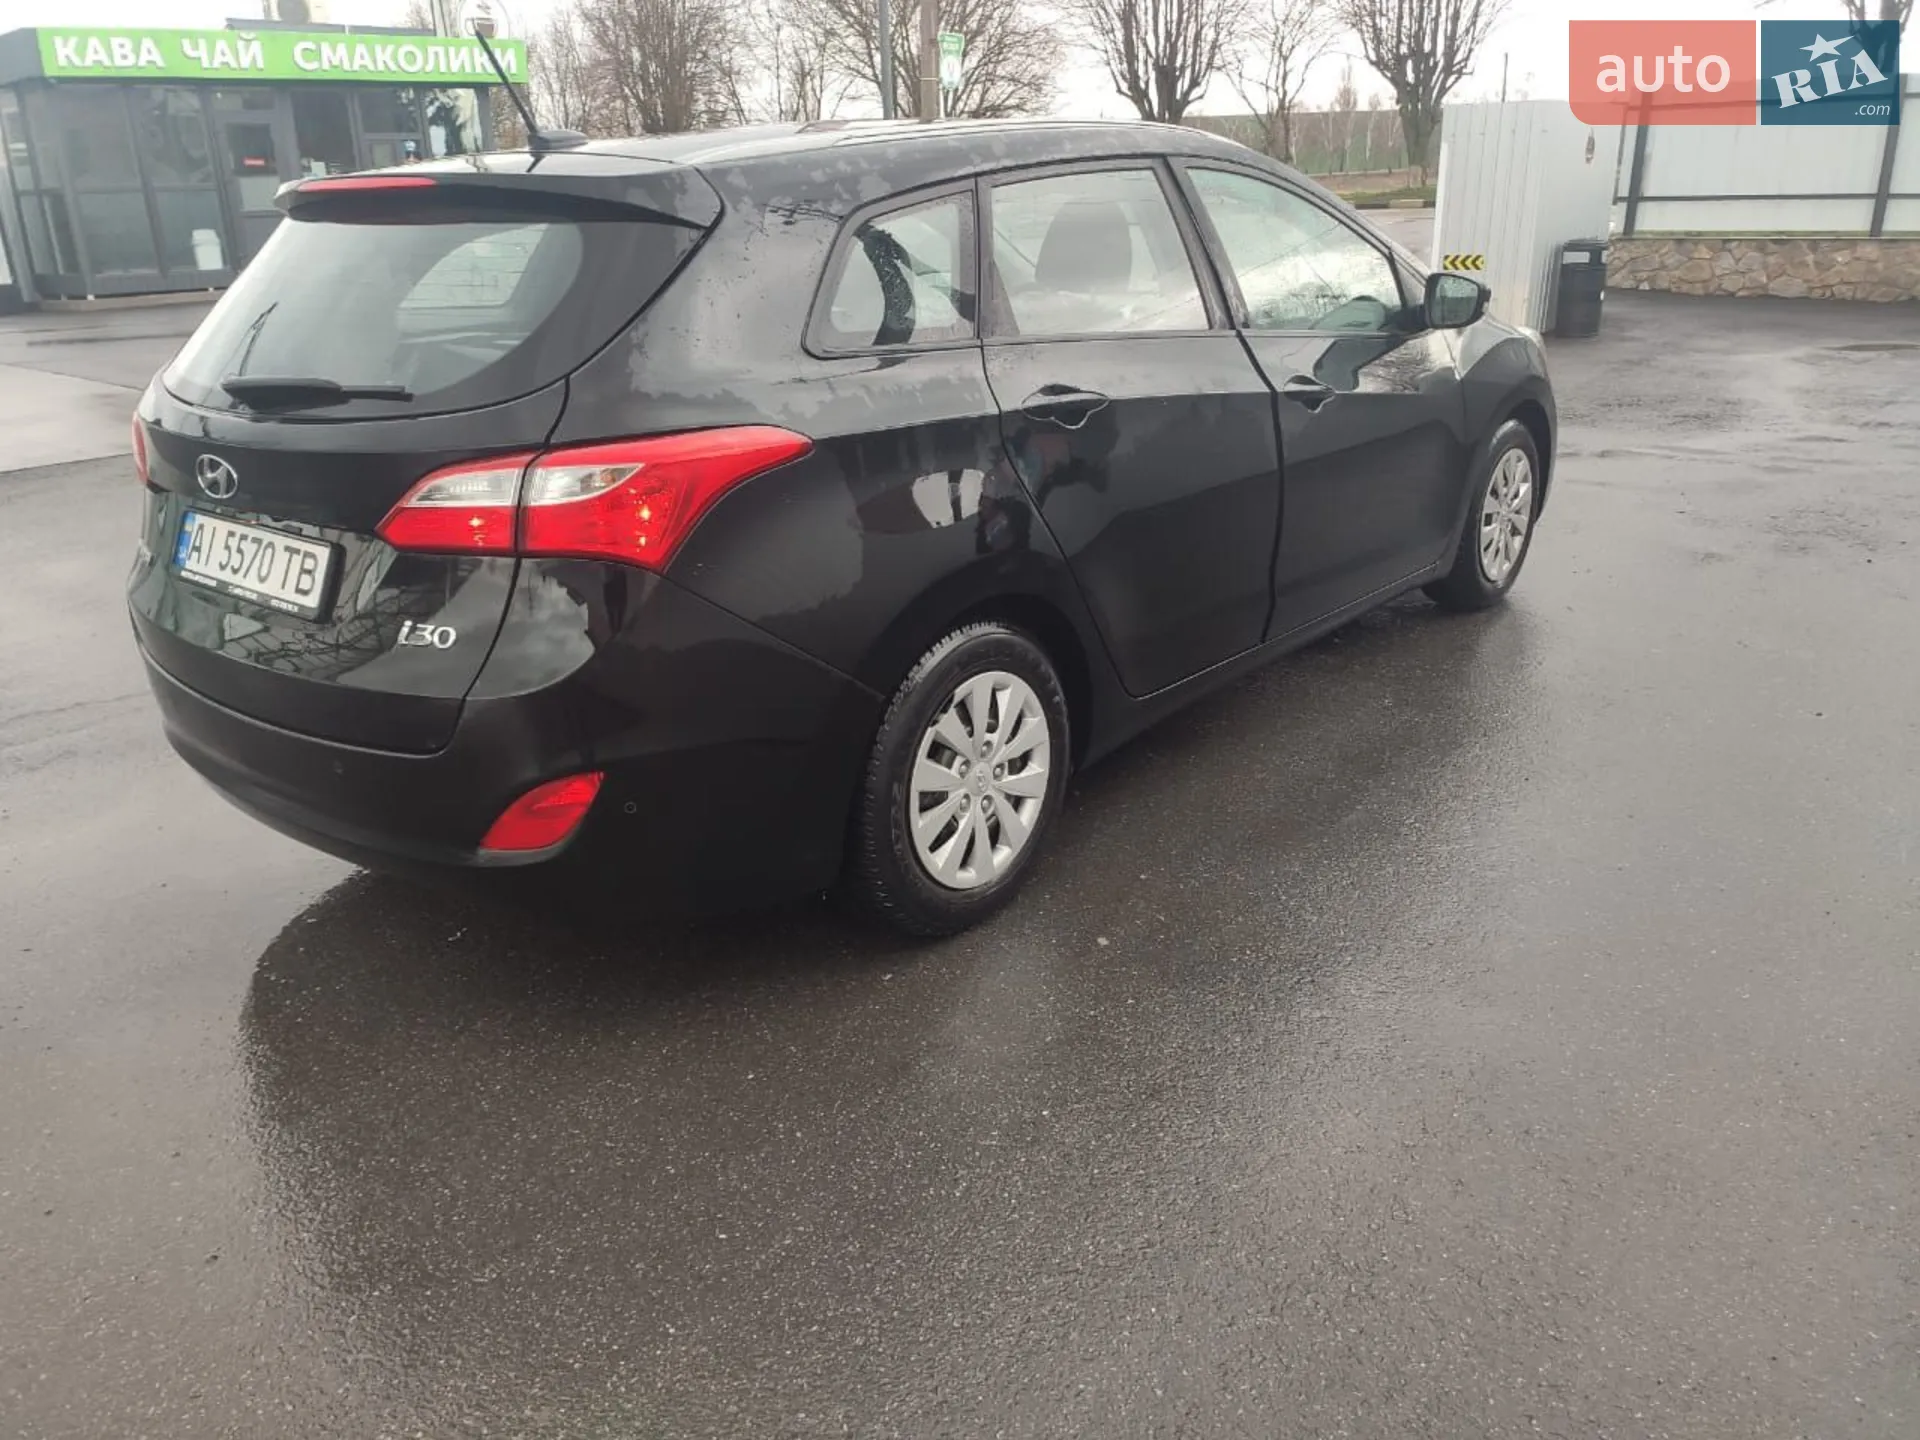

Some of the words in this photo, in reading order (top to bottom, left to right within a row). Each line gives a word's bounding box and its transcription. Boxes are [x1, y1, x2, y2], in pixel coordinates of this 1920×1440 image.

[53, 36, 165, 69] КАВА
[182, 33, 264, 70] ЧАЙ
[293, 40, 517, 75] СМАКОЛИКИ
[187, 523, 216, 566] AI
[219, 530, 275, 584] 5570
[281, 545, 319, 596] TB
[397, 620, 457, 649] i30
